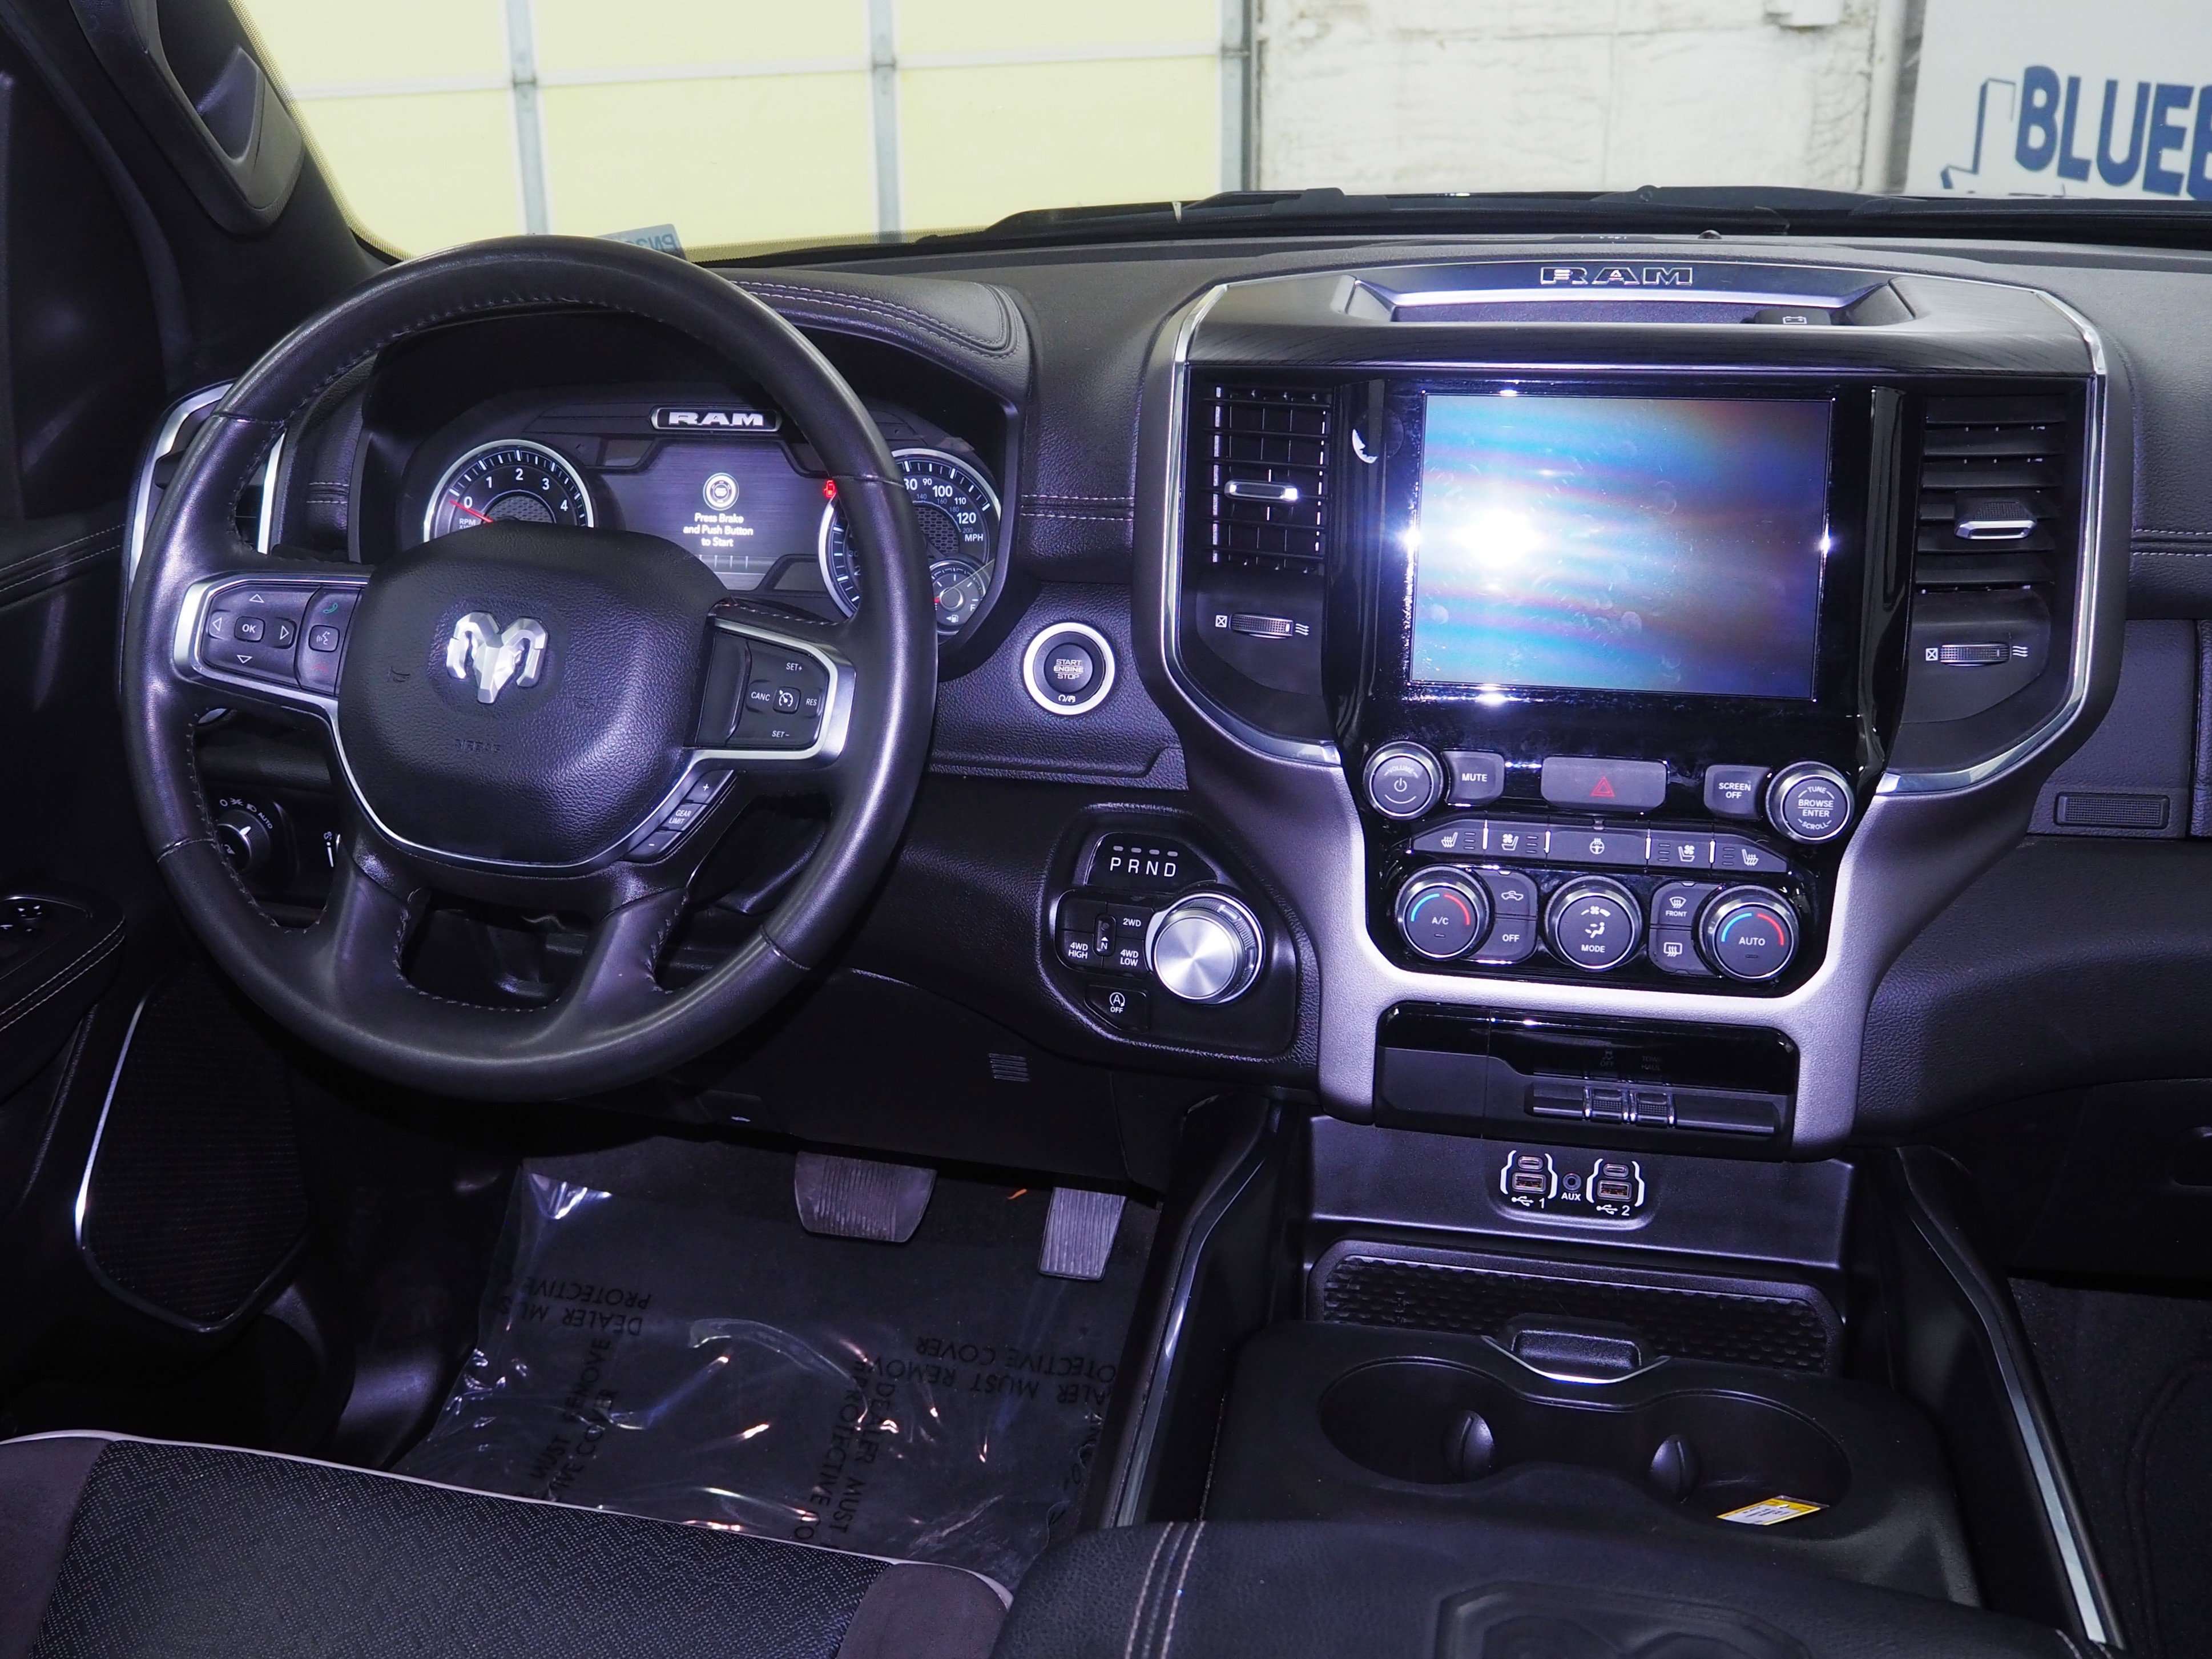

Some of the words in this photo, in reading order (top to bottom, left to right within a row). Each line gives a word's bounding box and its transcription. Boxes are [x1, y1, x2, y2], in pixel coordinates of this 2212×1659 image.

[1541, 267, 1693, 285] RAM
[668, 412, 764, 426] RAM
[515, 468, 523, 481] 2
[486, 476, 493, 488] 1
[542, 478, 550, 490] 3
[932, 485, 953, 497] 100
[464, 496, 473, 509] 0
[560, 499, 568, 512] 4
[694, 513, 718, 523] Press
[719, 513, 744, 523] Brake
[956, 512, 977, 524] 120
[683, 525, 700, 534] and
[702, 525, 723, 535] Push
[724, 526, 754, 535] Button
[701, 537, 710, 546] to
[712, 537, 734, 547] Start
[965, 534, 984, 542] MPH
[242, 624, 256, 633] OK
[751, 691, 771, 702] CANC
[1387, 765, 1415, 775] VOLUME
[1462, 773, 1488, 782] MUTE
[1718, 782, 1751, 792] SCREEN
[1798, 799, 1834, 808] BROWSE
[675, 809, 692, 818] GEAR
[1802, 809, 1830, 818] ENTER
[257, 812, 273, 829] AUTO
[1802, 821, 1828, 830] SCROLL
[1110, 857, 1121, 871] P
[1128, 859, 1140, 873] R
[1146, 861, 1159, 876] N
[1164, 863, 1176, 877] D
[1122, 917, 1142, 927] 2WD
[1431, 916, 1449, 925] A/C
[1070, 941, 1089, 951] 4WD
[1738, 936, 1766, 946] AUTO
[1581, 944, 1606, 953] MODE
[1068, 949, 1088, 959] HIGH
[1120, 949, 1139, 959] 4WD
[1120, 957, 1138, 967] LOW
[1561, 1192, 1581, 1202] AUX
[1539, 1198, 1545, 1209] 1
[1621, 1205, 1630, 1216] 2
[522, 1277, 652, 1310] PROTECTIVE
[561, 1308, 643, 1336] DEALER
[914, 1336, 997, 1367] COVER
[966, 1372, 1040, 1401] MUST
[1055, 1384, 1110, 1407] ALER
[828, 1476, 867, 1534] MUST
